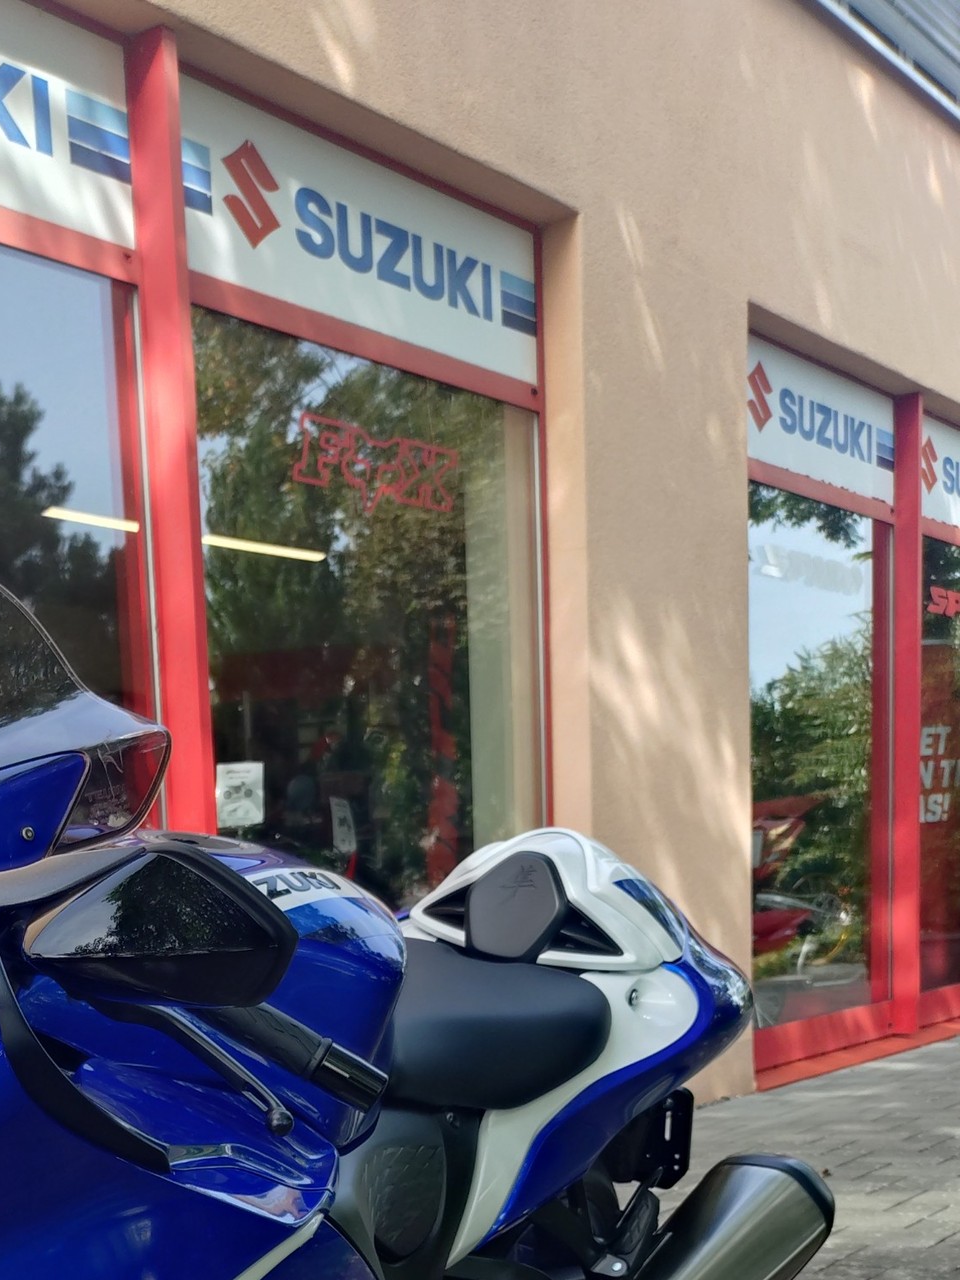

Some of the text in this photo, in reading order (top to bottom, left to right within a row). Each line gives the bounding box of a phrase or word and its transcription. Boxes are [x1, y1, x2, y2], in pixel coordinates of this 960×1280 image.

[294, 186, 494, 323] SUZUKI
[778, 388, 873, 464] SUZUKI
[942, 456, 960, 499] S
[252, 871, 342, 900] ZUKI
